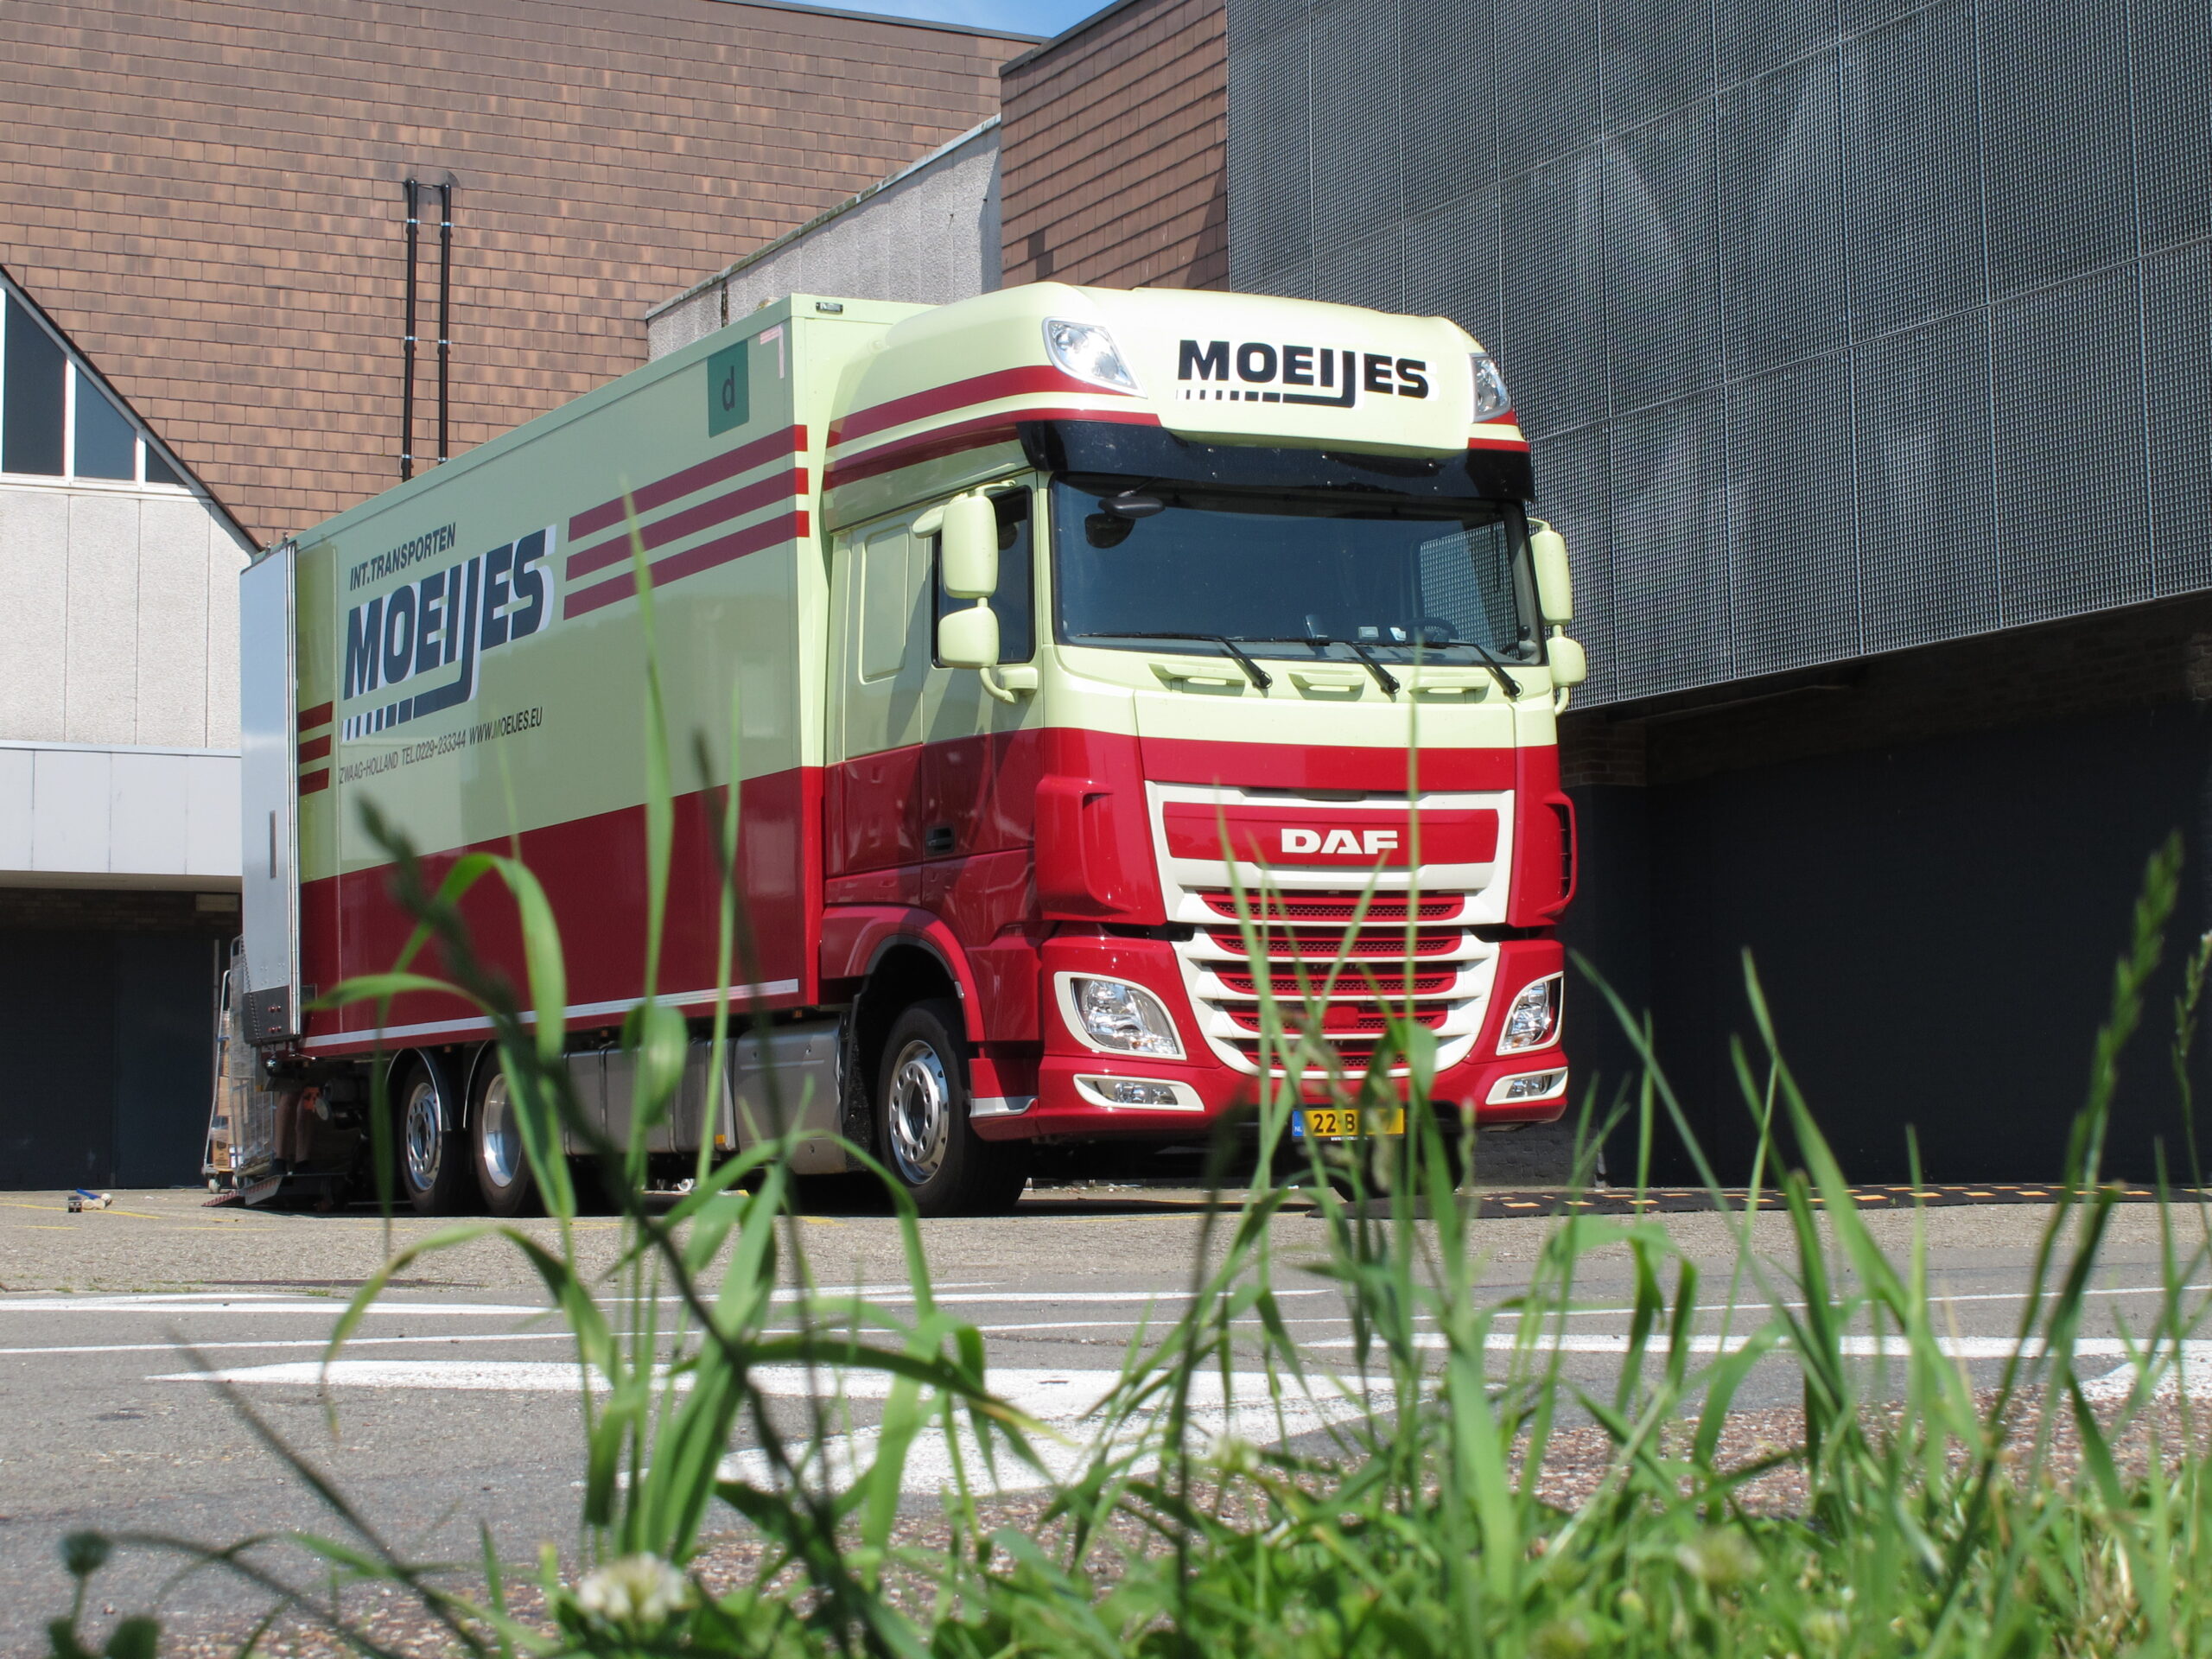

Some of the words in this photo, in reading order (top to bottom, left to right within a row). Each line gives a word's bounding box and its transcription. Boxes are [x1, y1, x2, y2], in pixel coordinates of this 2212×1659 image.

[722, 365, 735, 411] d
[1178, 340, 1430, 408] MOEIJES
[350, 522, 456, 591] INT.TRANSPORTEN
[343, 526, 550, 719] MOEIJES
[339, 753, 399, 785] ZWAAG-HOLLAND
[402, 732, 466, 766] TEL.0229-233344
[1281, 828, 1398, 855] DAF
